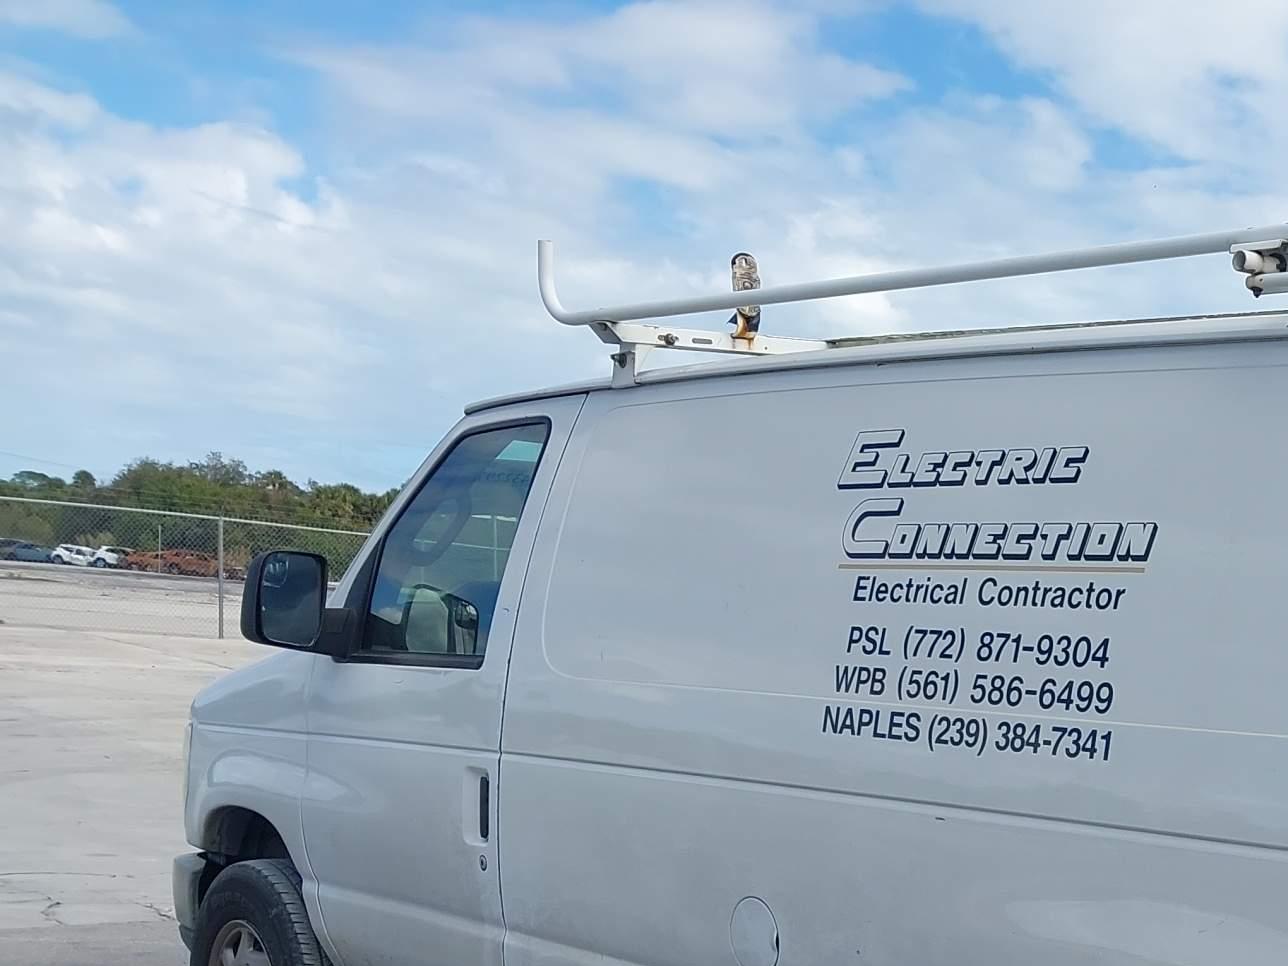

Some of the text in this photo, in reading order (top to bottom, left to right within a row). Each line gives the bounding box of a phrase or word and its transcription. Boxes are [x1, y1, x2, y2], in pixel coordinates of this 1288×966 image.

[837, 429, 1089, 489] ELECTRIC
[842, 498, 1158, 562] CONNECTION
[853, 576, 1125, 610] Electrical Contractor
[846, 626, 1111, 669] PSL (772) 871-9304
[834, 665, 1114, 714] WPB (561) 586-6499
[822, 706, 1113, 761] NAPLES (239) 384-7341
